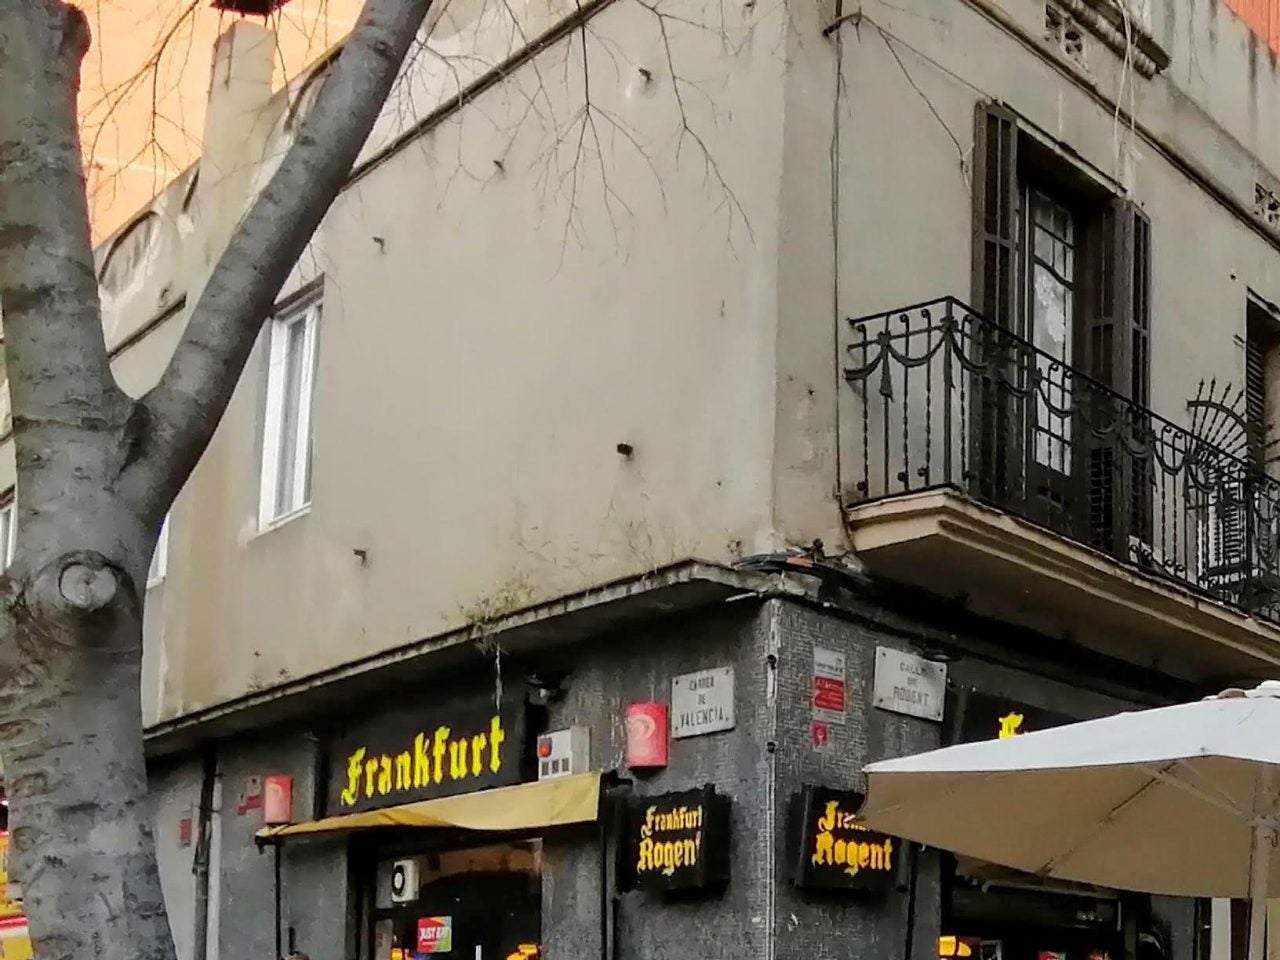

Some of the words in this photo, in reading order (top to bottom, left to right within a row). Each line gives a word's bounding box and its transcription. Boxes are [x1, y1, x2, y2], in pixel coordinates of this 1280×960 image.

[341, 715, 505, 806] Frankfurt
[811, 831, 893, 877] Rogent
[419, 927, 437, 942] JUST
